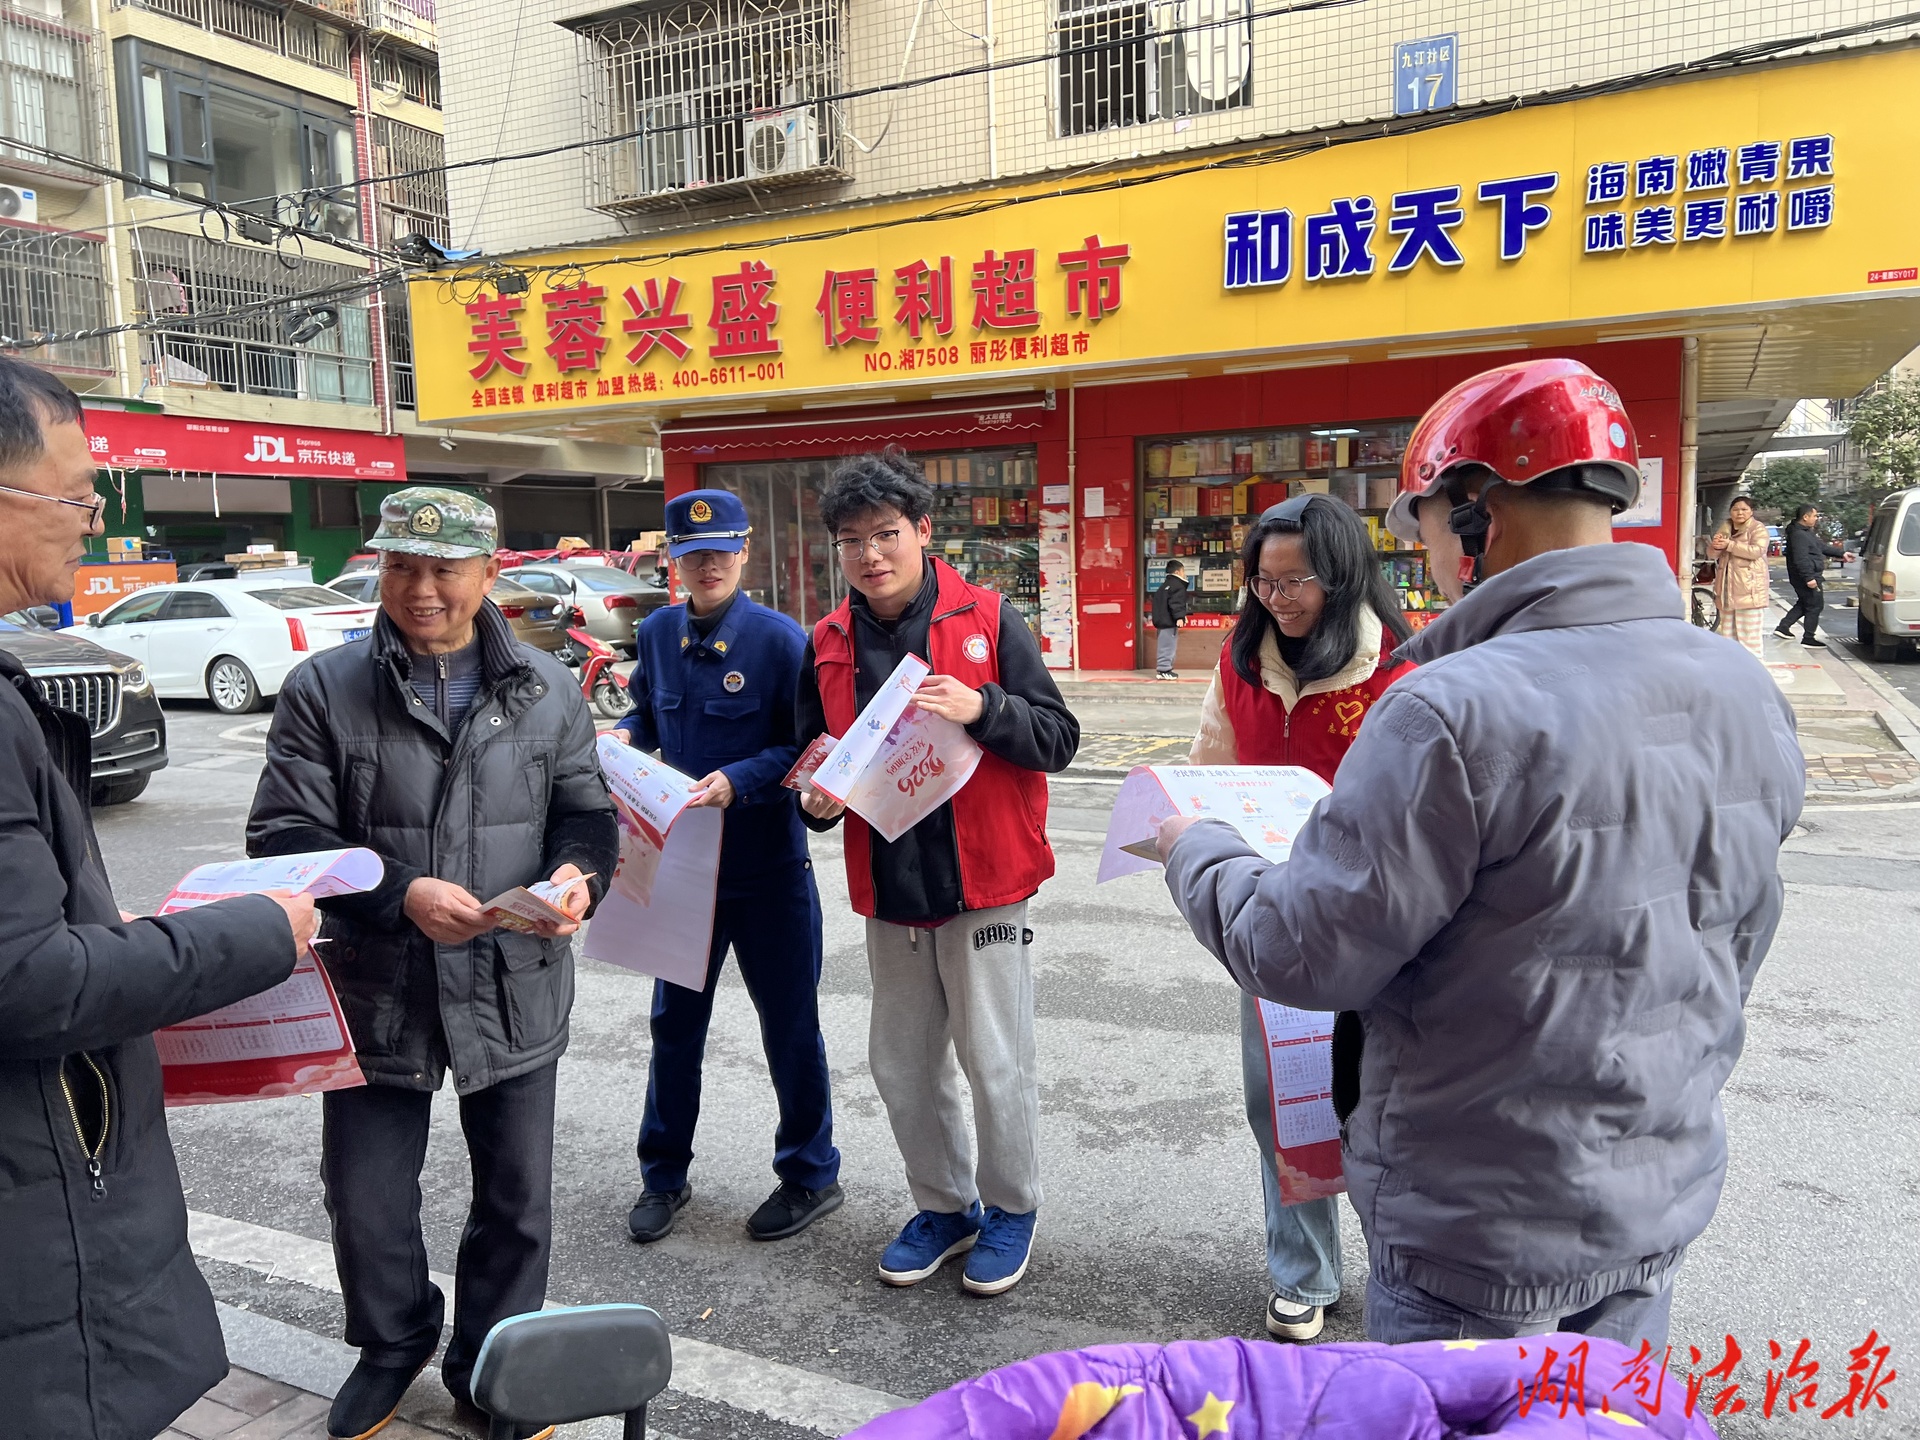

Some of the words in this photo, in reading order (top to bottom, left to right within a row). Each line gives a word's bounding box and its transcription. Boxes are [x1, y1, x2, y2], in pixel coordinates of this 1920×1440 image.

[1402, 45, 1450, 69] 九江社区
[1408, 73, 1443, 110] 17
[1586, 134, 1835, 204] 海南嫩青果
[1224, 171, 1559, 289] 和成天下
[1585, 183, 1835, 253] 味美更耐嚼
[465, 259, 783, 381] 芙蓉兴盛
[815, 234, 1131, 347] 便利超市
[864, 345, 959, 372] NO.湘7508
[969, 331, 1090, 364] 丽彤便利超市
[471, 385, 525, 408] 全国连锁
[532, 379, 588, 402] 便利超市
[672, 362, 785, 388] 400-6611-001
[84, 436, 110, 453] 递
[243, 435, 295, 463] JDL
[296, 438, 321, 447] Express
[297, 449, 356, 466] 京东快递
[83, 576, 121, 596] JDL
[1190, 618, 1220, 627] 欢迎光临
[973, 923, 1017, 951] BADS
